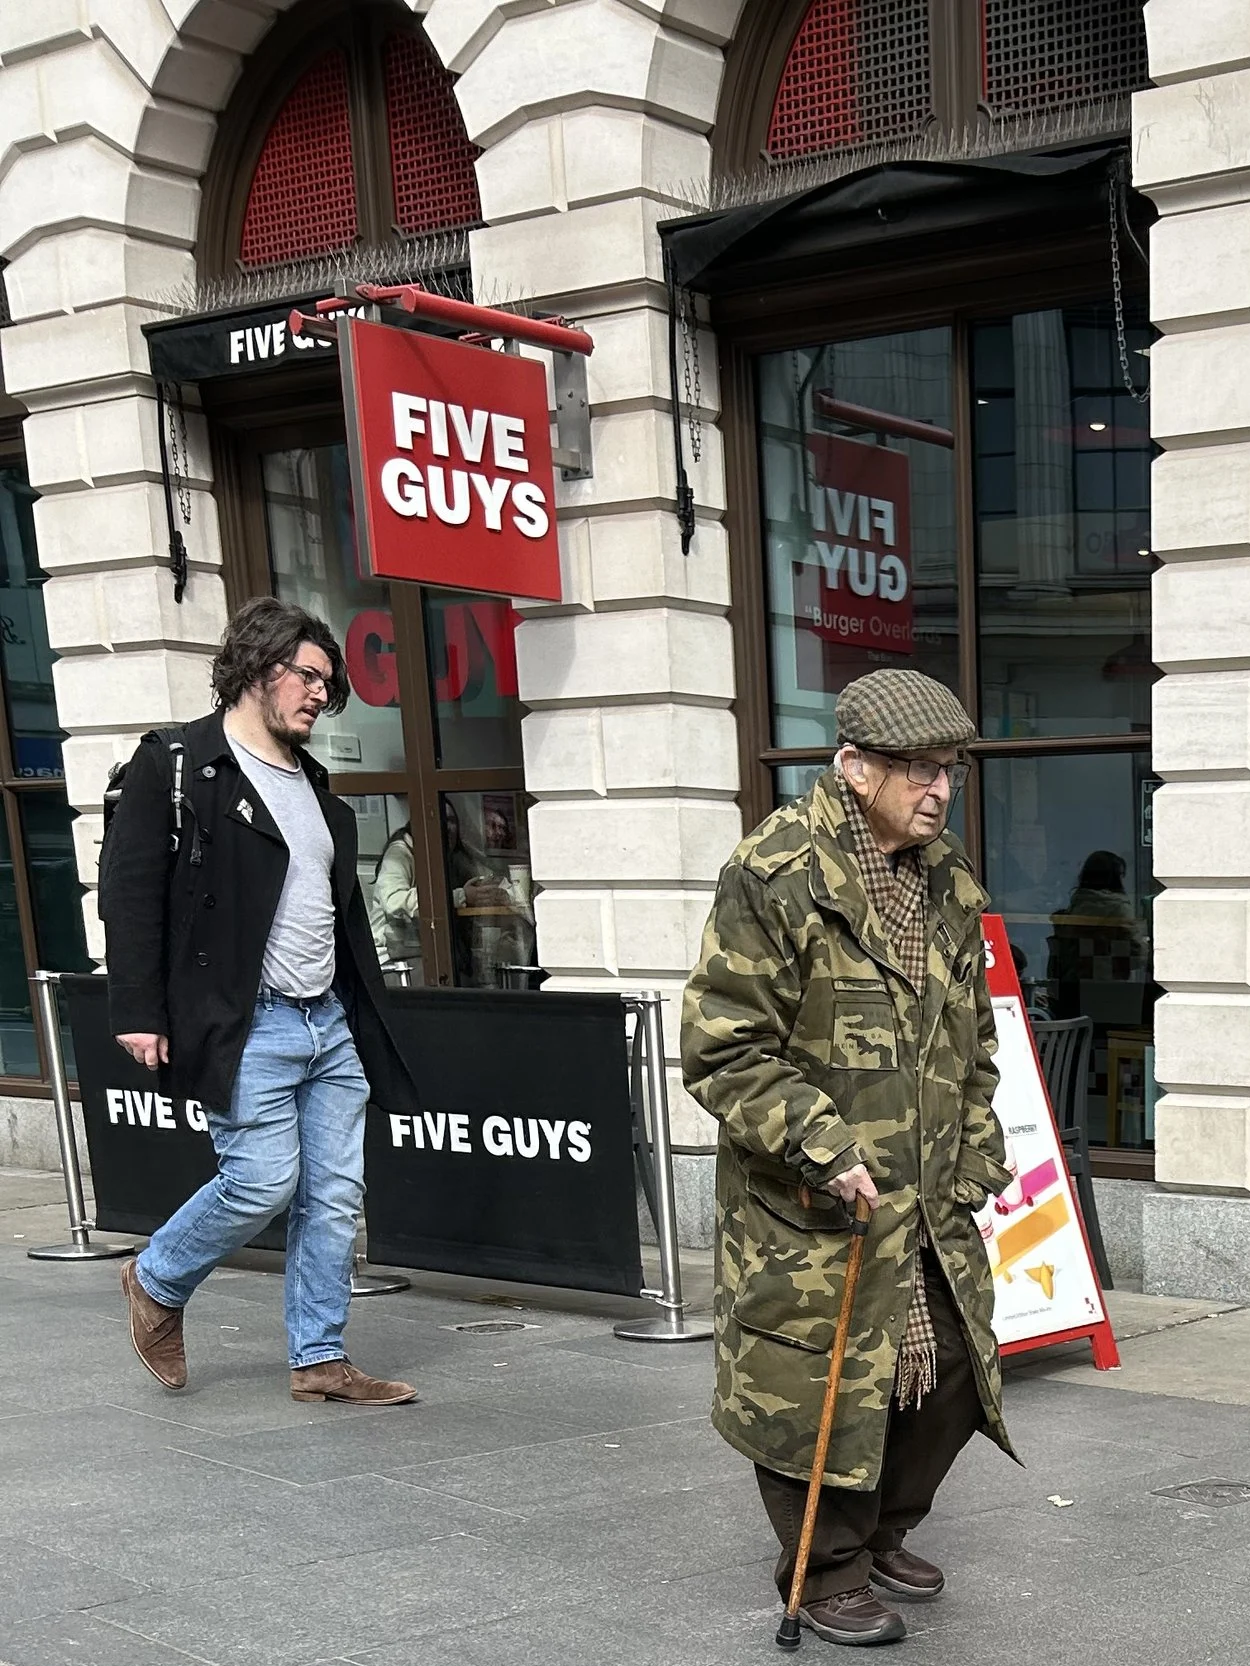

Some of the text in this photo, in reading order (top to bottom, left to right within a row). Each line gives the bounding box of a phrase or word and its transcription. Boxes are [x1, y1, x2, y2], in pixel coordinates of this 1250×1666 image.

[229, 320, 287, 364] FIVE
[391, 391, 530, 473] FIVE
[380, 457, 549, 539] GUYS
[106, 1088, 177, 1129] FIVE
[389, 1111, 592, 1163] FIVE GUYS
